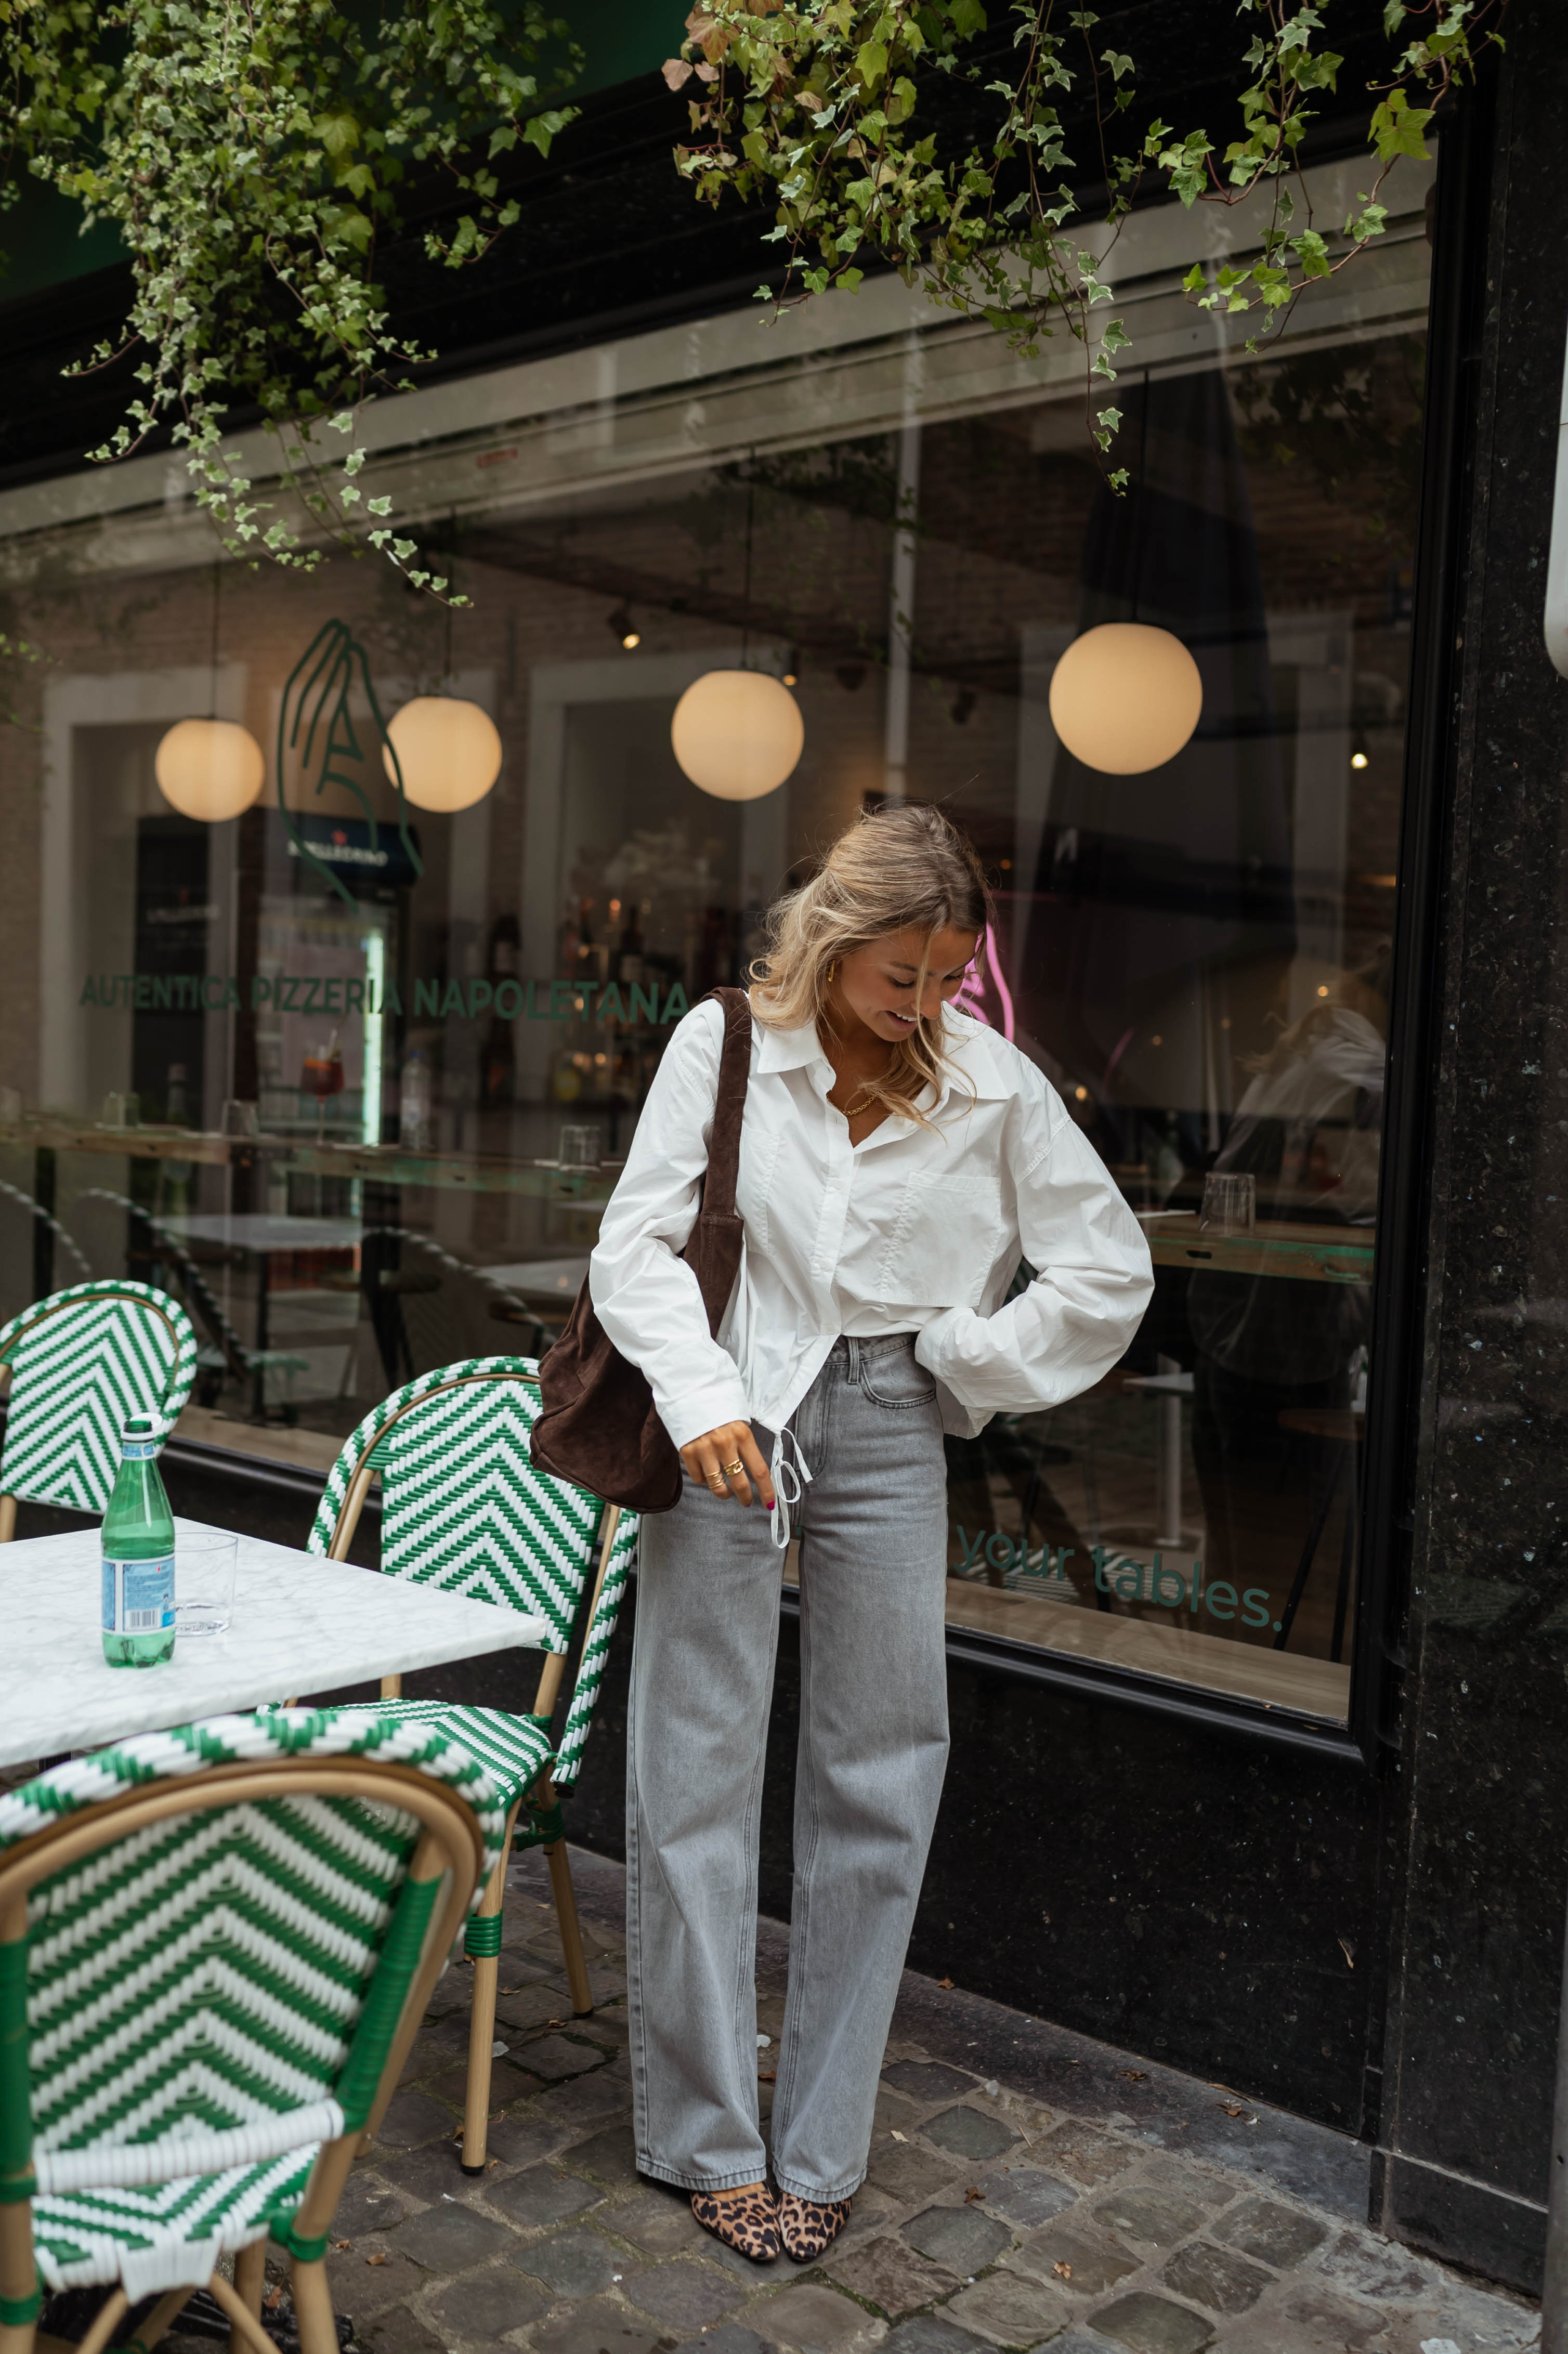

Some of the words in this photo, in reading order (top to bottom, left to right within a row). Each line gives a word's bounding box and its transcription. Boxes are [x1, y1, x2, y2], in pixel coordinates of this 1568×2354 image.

[80, 974, 241, 1012] AUTENTICA
[251, 975, 402, 1015] PIZZERIA
[414, 979, 690, 1024] NAPOLETANA
[954, 1524, 1075, 1581] your
[1091, 1546, 1283, 1632] tables.
